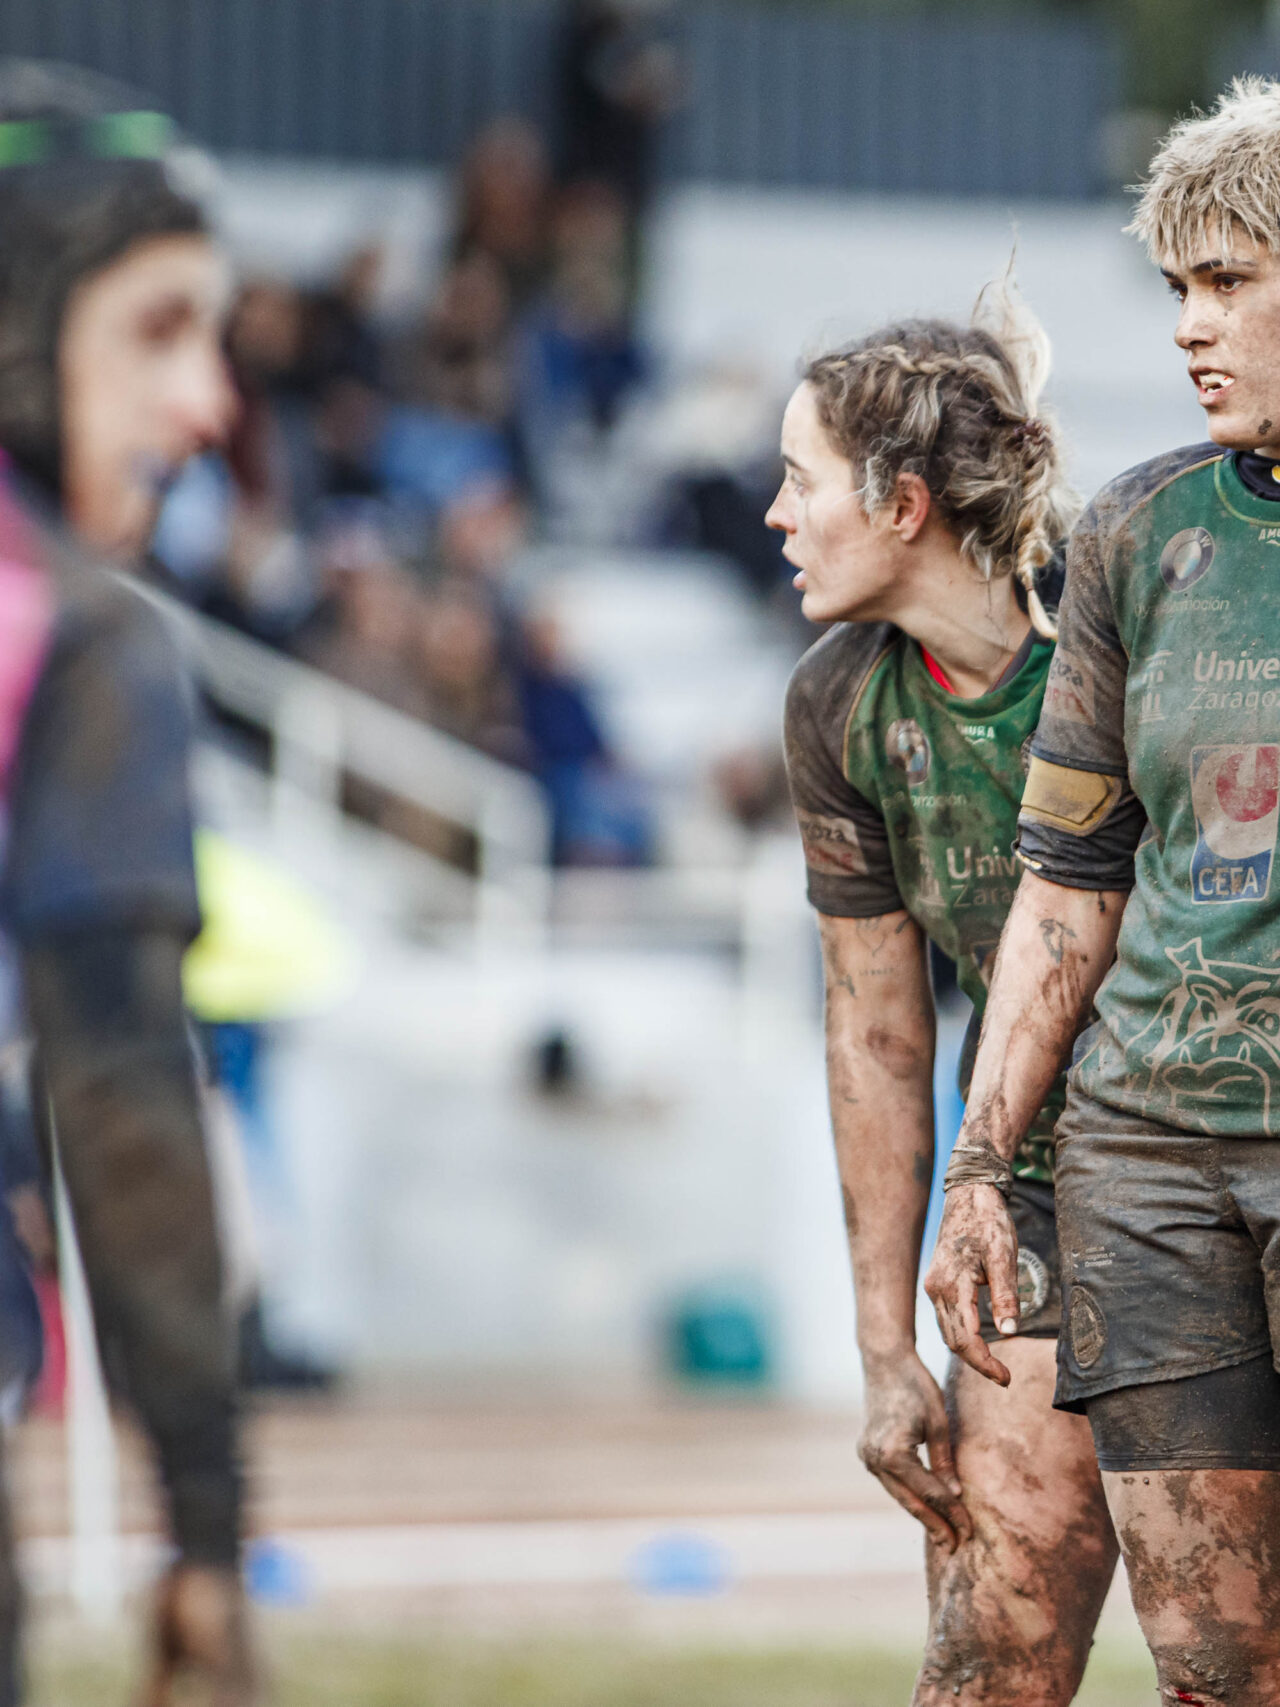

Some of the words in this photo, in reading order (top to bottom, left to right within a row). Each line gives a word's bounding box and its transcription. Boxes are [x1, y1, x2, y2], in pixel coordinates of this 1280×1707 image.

[946, 845, 1024, 881] Univ
[952, 884, 1018, 908] Zara
[1198, 866, 1260, 896] CEFA
